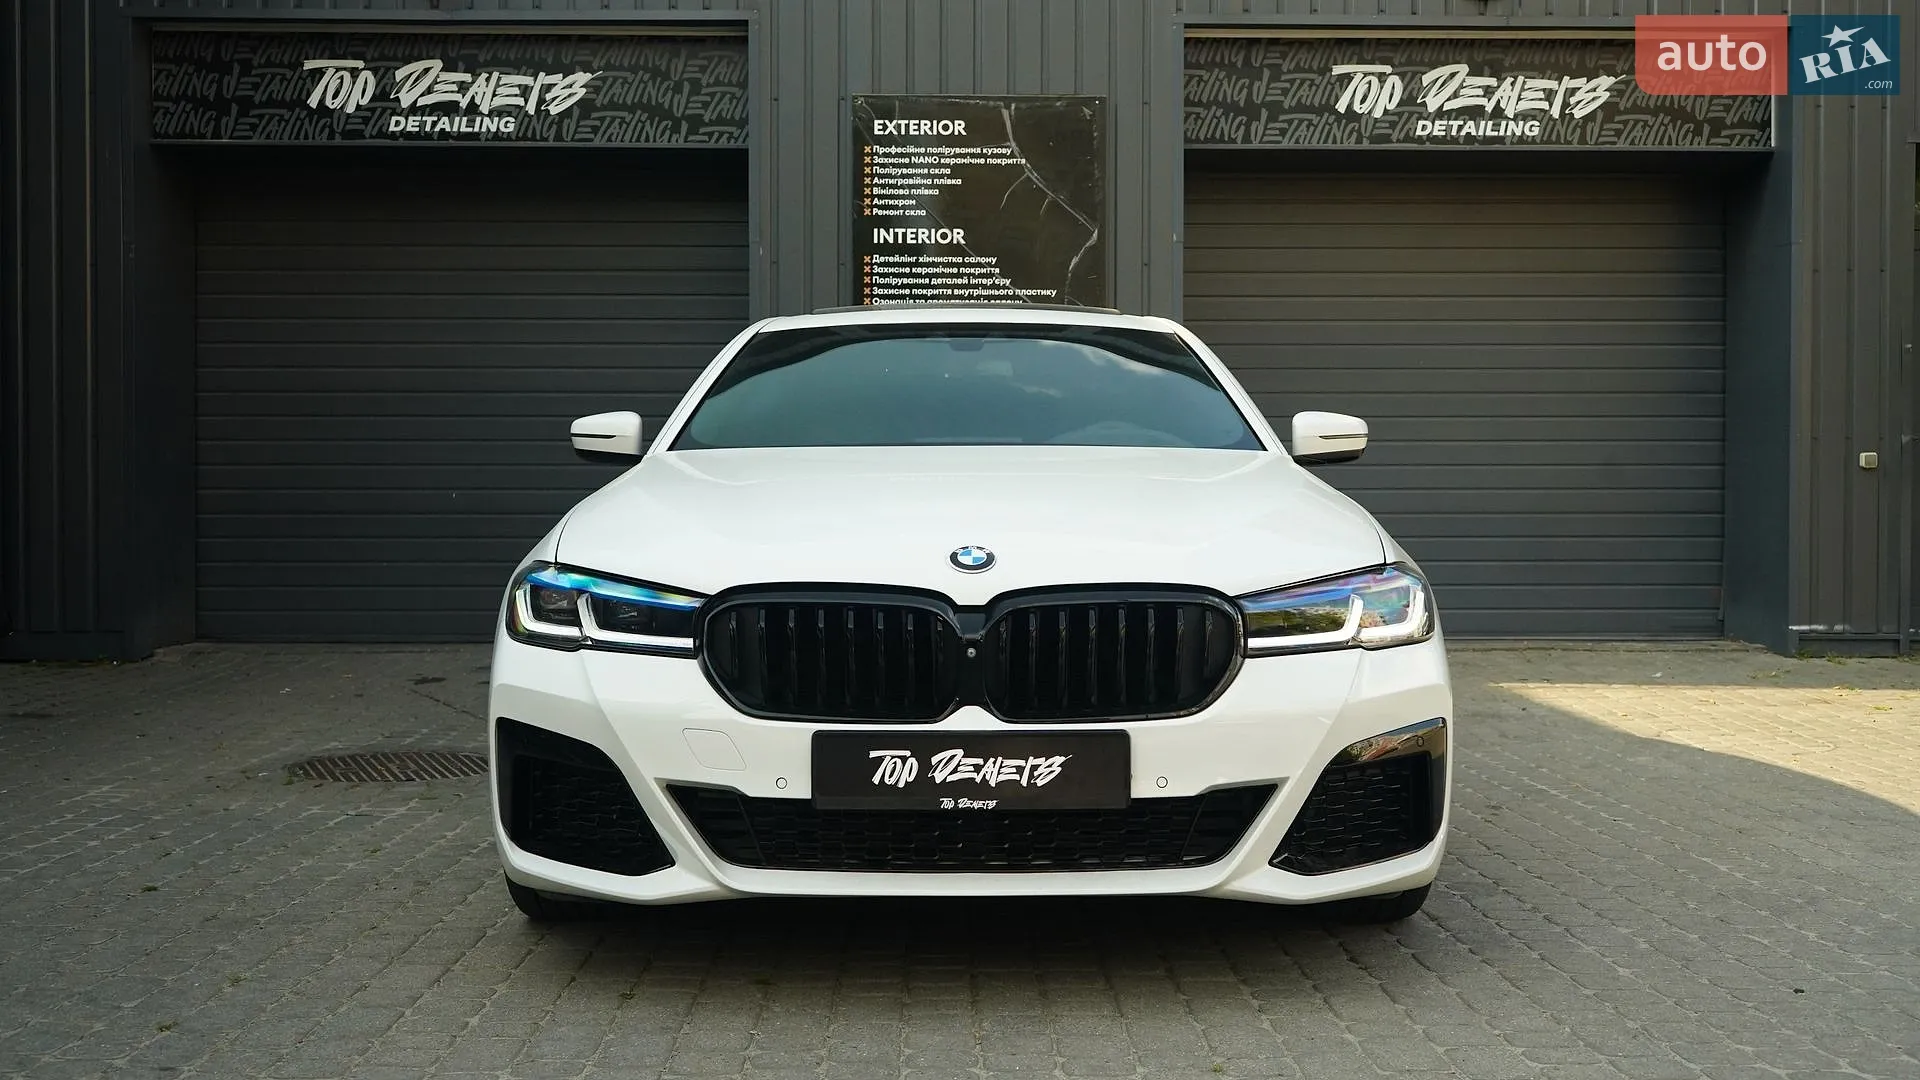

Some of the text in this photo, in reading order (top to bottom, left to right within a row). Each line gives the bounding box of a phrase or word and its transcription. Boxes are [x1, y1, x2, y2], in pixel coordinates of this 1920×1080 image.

[388, 114, 516, 133] DETAILING
[873, 119, 967, 136] EXTERIOR
[1415, 119, 1541, 137] DETAILING
[873, 145, 1012, 156] Професійне полірування кузову
[873, 156, 1026, 166] Захисне NANO керамічне покриття
[873, 166, 928, 176] Полірування
[873, 176, 962, 186] Антигравійна плівка
[873, 187, 939, 195] Вінілова плівка
[873, 197, 916, 207] Антихром
[873, 208, 904, 216] Ремонт
[873, 228, 966, 244] INTERIOR
[872, 254, 917, 264] Детейлінг
[964, 256, 997, 265] салону
[873, 265, 1000, 275] Захисне керамічне покриття
[873, 276, 929, 286] Полірування
[931, 276, 968, 285] деталей
[872, 286, 1057, 297] Захисне покриття внутрішнього пластику
[869, 749, 919, 788] TOP
